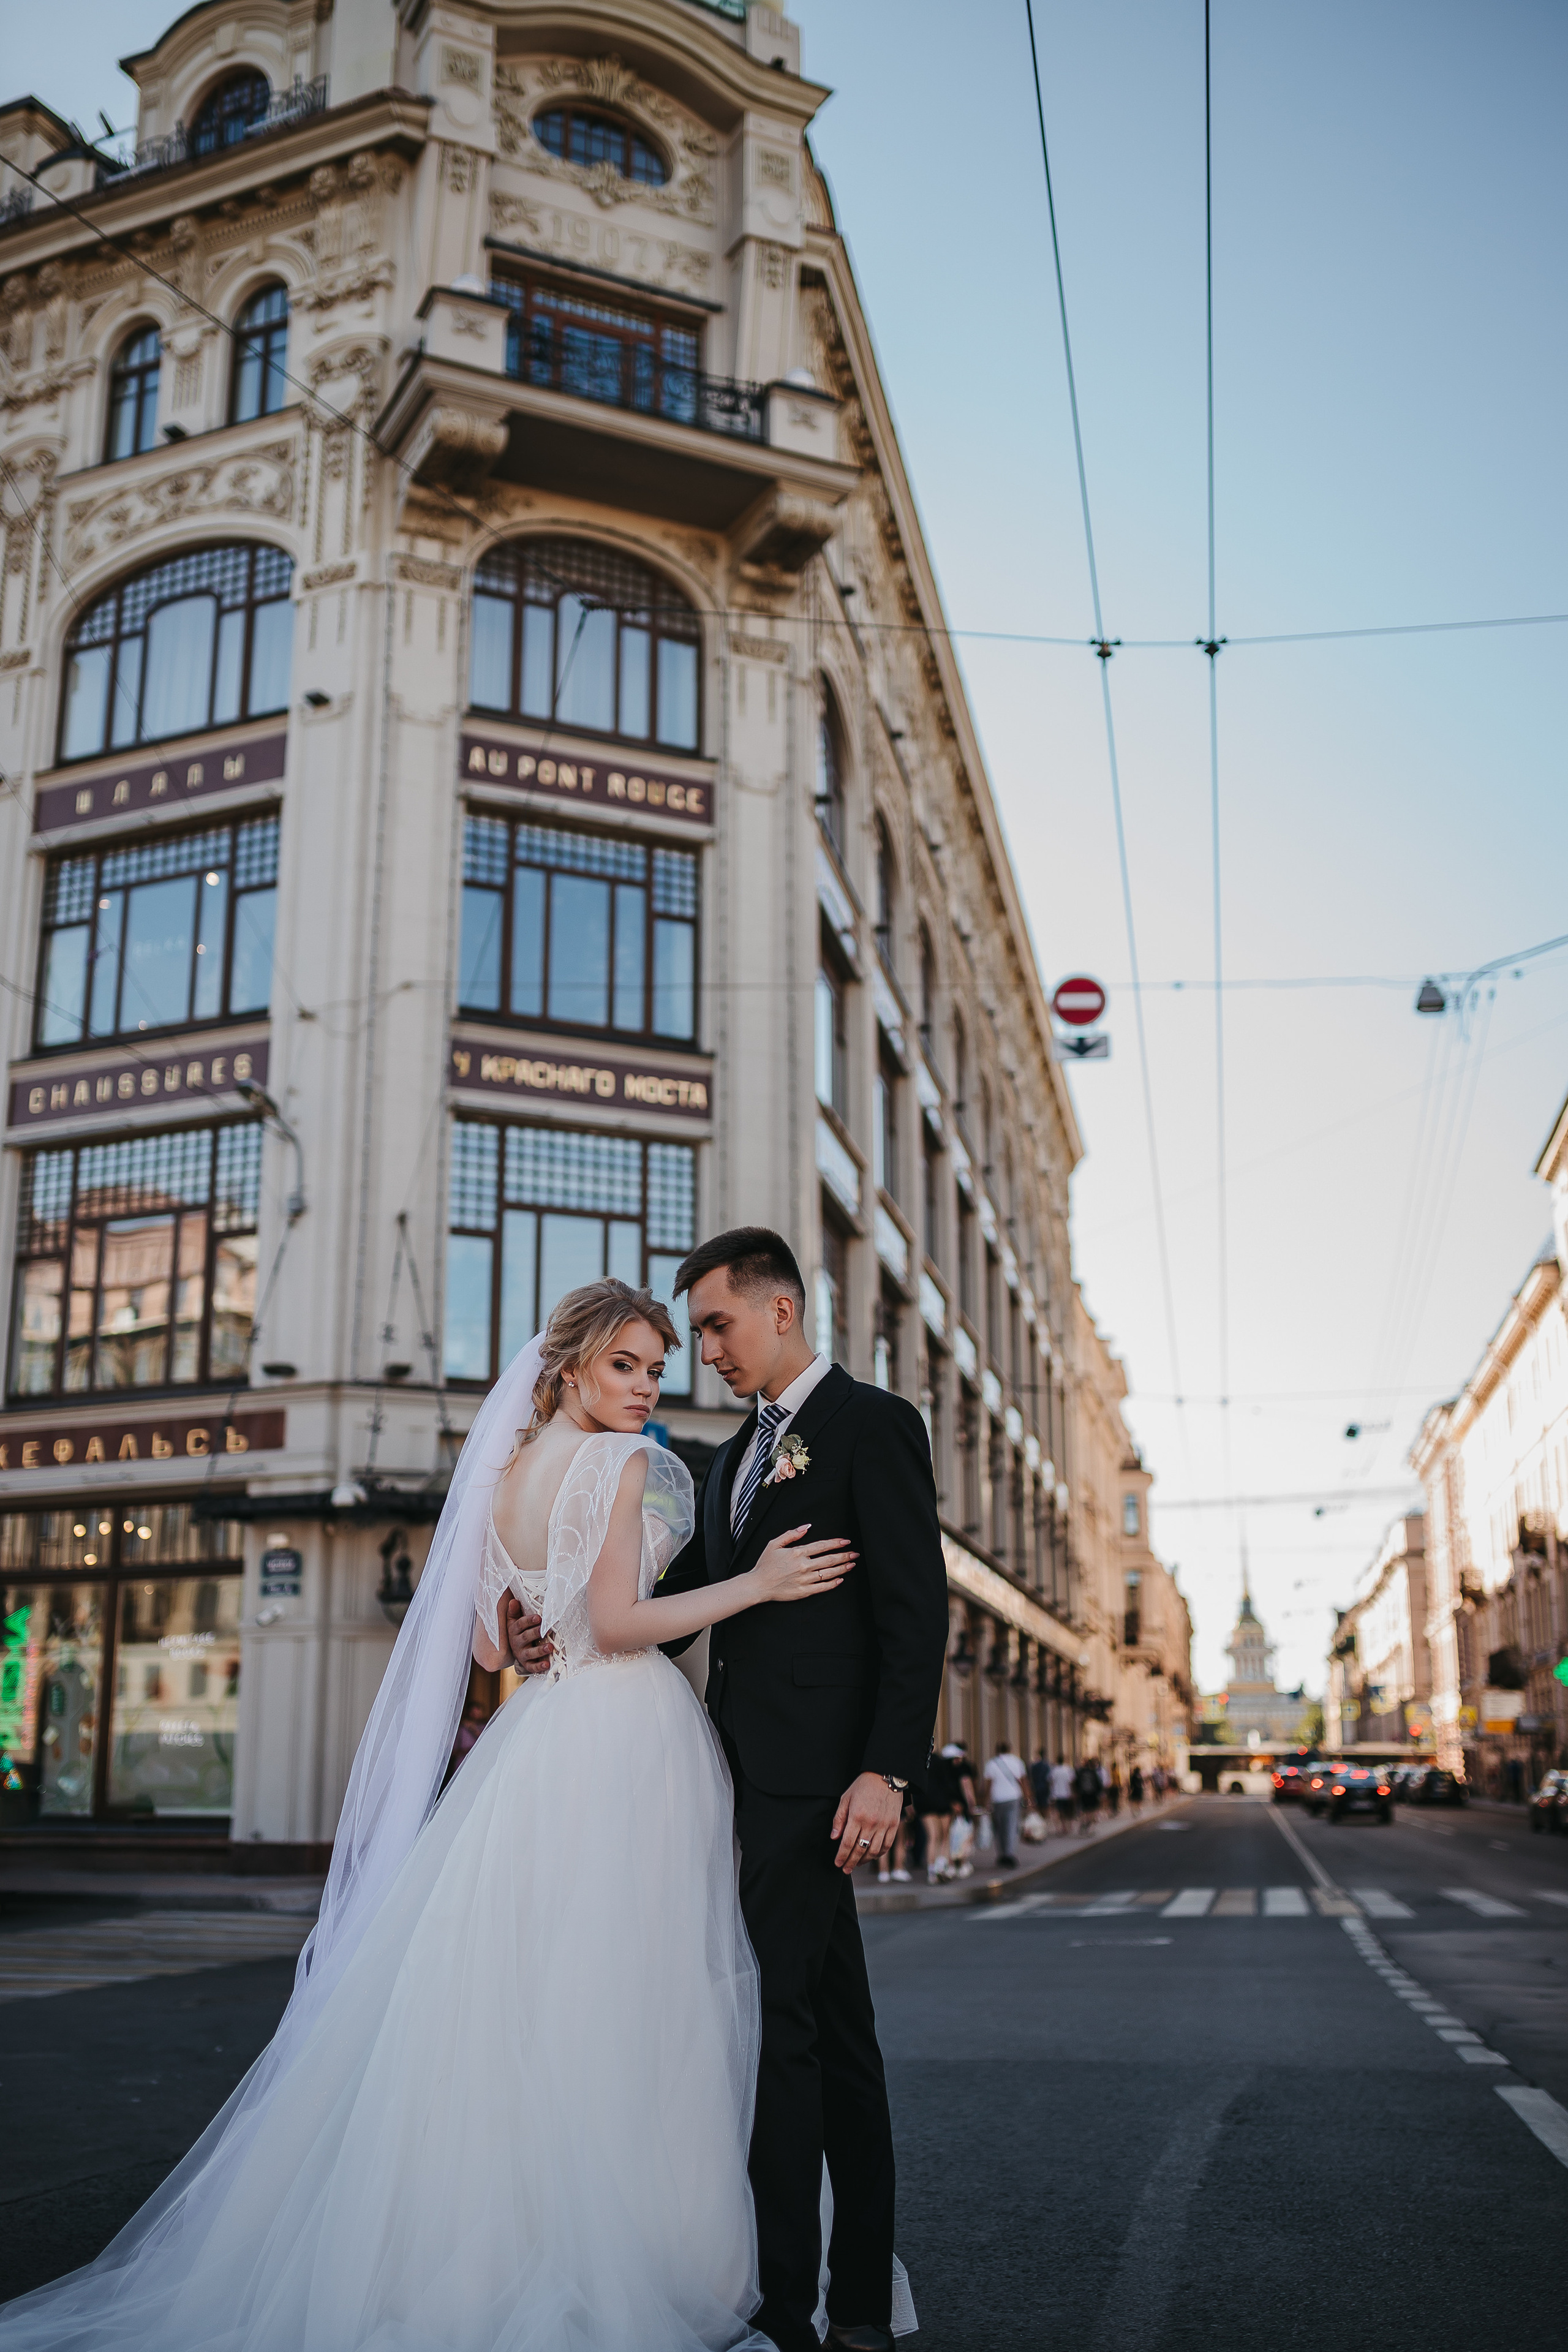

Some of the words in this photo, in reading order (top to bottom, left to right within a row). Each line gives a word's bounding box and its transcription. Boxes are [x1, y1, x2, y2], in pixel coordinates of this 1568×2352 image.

[551, 214, 647, 270] 1907
[469, 746, 508, 777] AU
[518, 755, 597, 793] PONT
[607, 772, 706, 815] ROUGE
[28, 1053, 253, 1114] CHAUSSURES
[453, 1050, 472, 1078] У
[625, 1073, 708, 1110] МОСТА
